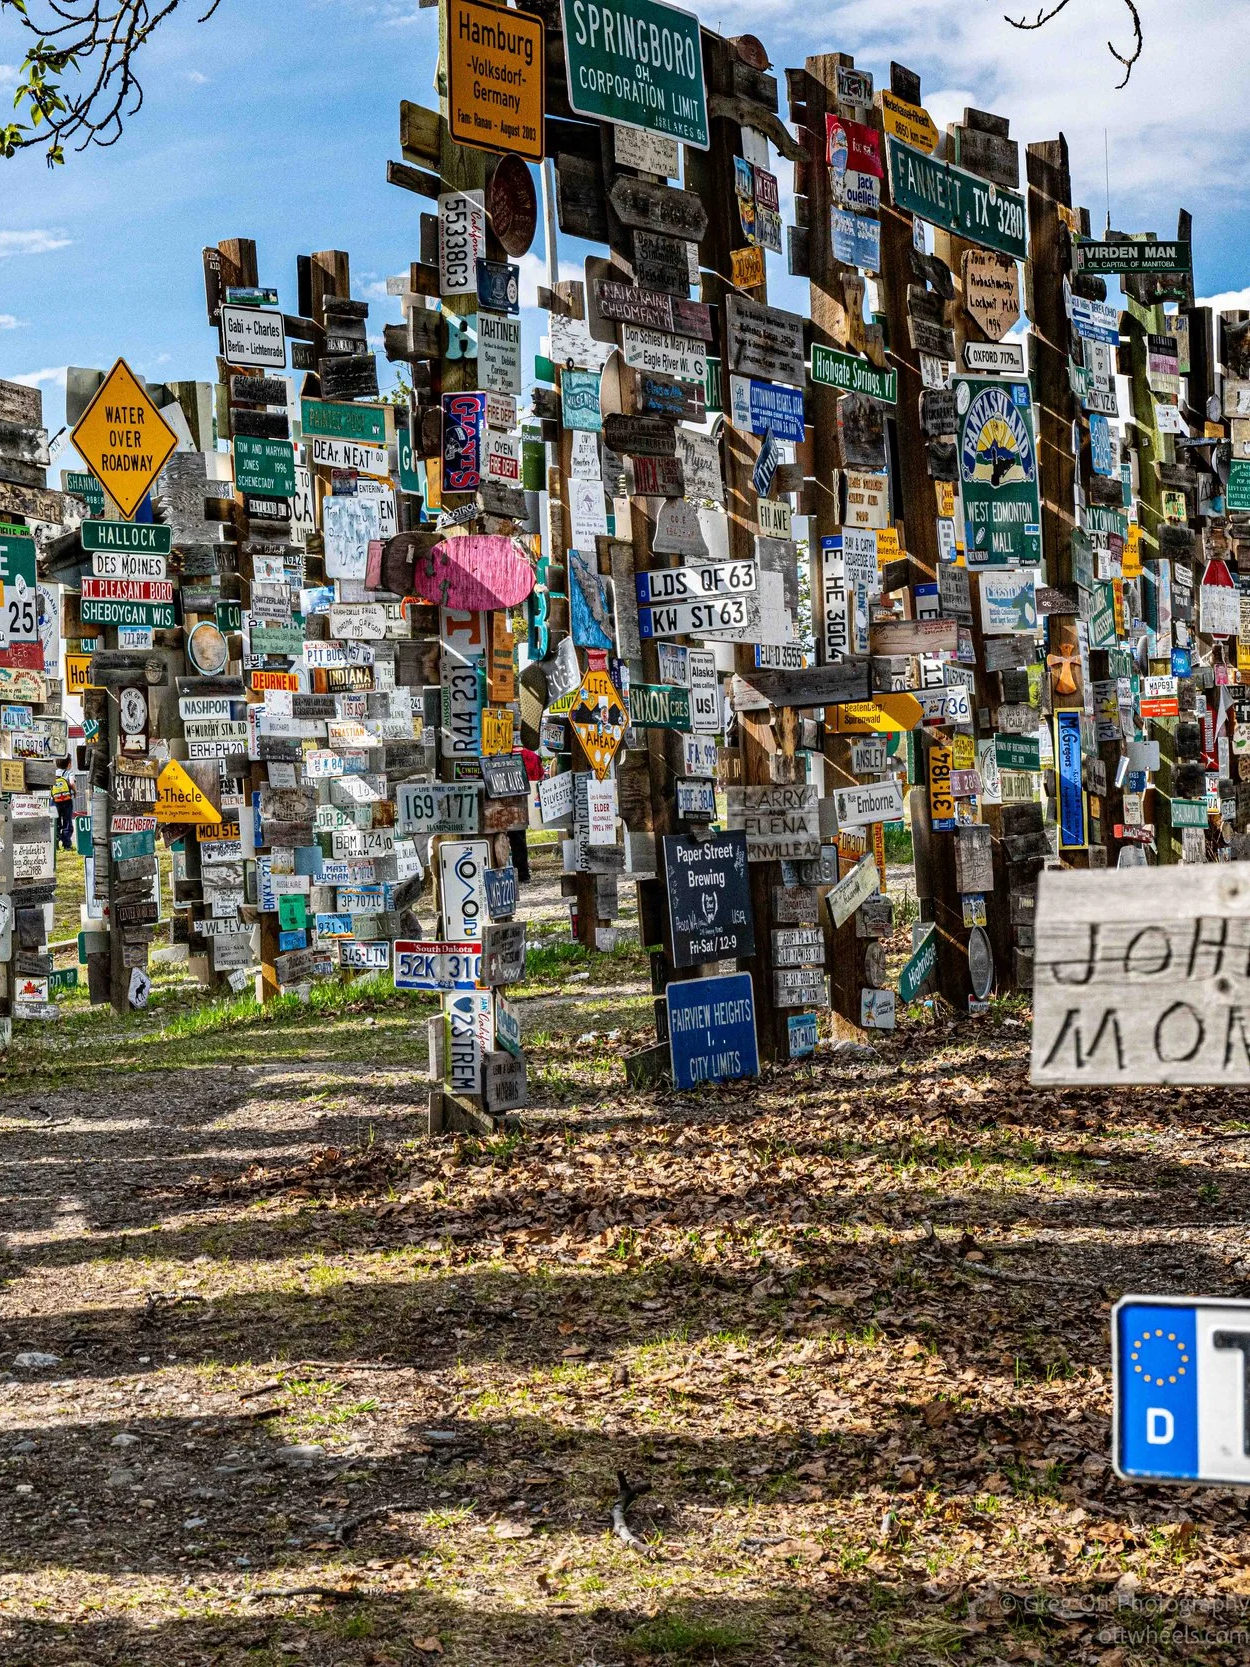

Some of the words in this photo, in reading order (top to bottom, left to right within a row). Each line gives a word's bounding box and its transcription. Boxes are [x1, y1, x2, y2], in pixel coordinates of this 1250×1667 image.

[459, 11, 533, 65] Hamburg
[574, 0, 696, 80] SPRINGBORO
[467, 56, 526, 87] -Volksdorf-
[474, 82, 520, 113] Germany
[579, 66, 665, 110] CORPORATION
[672, 94, 698, 121] LIMIT
[898, 152, 961, 216] FANNETT
[973, 187, 989, 227] TX
[998, 198, 1023, 240] 3280
[1085, 247, 1143, 258] VIRDEN
[1145, 247, 1177, 258] MAN.
[228, 317, 243, 333] Gabi
[254, 320, 279, 337] Charles
[480, 318, 519, 343] TAHTINEN
[228, 342, 244, 354] Berlin
[251, 342, 282, 358] Lichtenrade
[626, 325, 636, 340] Don
[671, 337, 685, 353] Mary
[687, 341, 704, 356] Akins
[644, 353, 662, 369] Eagle
[663, 355, 679, 371] River
[973, 350, 998, 364] OXFORD
[816, 356, 850, 386] Highgate
[884, 380, 894, 405] VT
[105, 407, 144, 425] WATER
[962, 390, 1029, 457] FANTASYLAND
[110, 431, 141, 448] OVER
[450, 397, 481, 488] GIANTS
[101, 454, 153, 472] ROADWAY
[967, 501, 988, 522] WEST
[992, 501, 1032, 523] EDMONTON
[98, 526, 155, 547] HALLOCK
[992, 532, 1013, 553] MALL
[98, 557, 115, 573] DES
[122, 557, 161, 576] MOINES
[100, 581, 144, 599] PLEASANT
[150, 582, 172, 600] BORO
[651, 574, 687, 596] LDS
[701, 569, 724, 591] QF
[730, 565, 752, 588] 63
[9, 602, 34, 633] 25
[82, 602, 146, 625] SHEBOYGAN
[152, 608, 173, 625] WIS.
[653, 610, 677, 632] KW
[692, 605, 714, 627] ST
[720, 602, 744, 624] 63
[328, 670, 371, 685] INDIANA
[453, 662, 477, 701] 231
[692, 666, 714, 677] Alaska
[587, 679, 608, 694] LIFE
[631, 689, 669, 723] NIXON
[671, 702, 689, 717] CRES
[696, 700, 715, 714] us!
[330, 727, 364, 738] SEBASTIAN
[453, 708, 477, 752] R44
[586, 732, 616, 749] AHEAD
[856, 753, 885, 768] ANSLEY
[745, 791, 804, 808] LARRY
[858, 795, 893, 813] Emborne
[113, 818, 155, 830] MARIENBERG
[744, 817, 808, 833] ELENA
[677, 846, 702, 863] Paper
[705, 844, 733, 859] Street
[688, 872, 725, 887] Brewing
[441, 945, 472, 953] Dakota
[690, 938, 713, 955] Fri-Sat
[720, 935, 737, 951] 12-9
[1051, 917, 1250, 985] JOH
[400, 954, 435, 977] 52K
[908, 941, 936, 990] Highbridge
[672, 1005, 710, 1032] FAIRVIEW
[715, 998, 750, 1023] HEIGHTS
[690, 1056, 710, 1081] CITY
[712, 1051, 741, 1076] LIMITS
[1147, 1408, 1174, 1444] D
